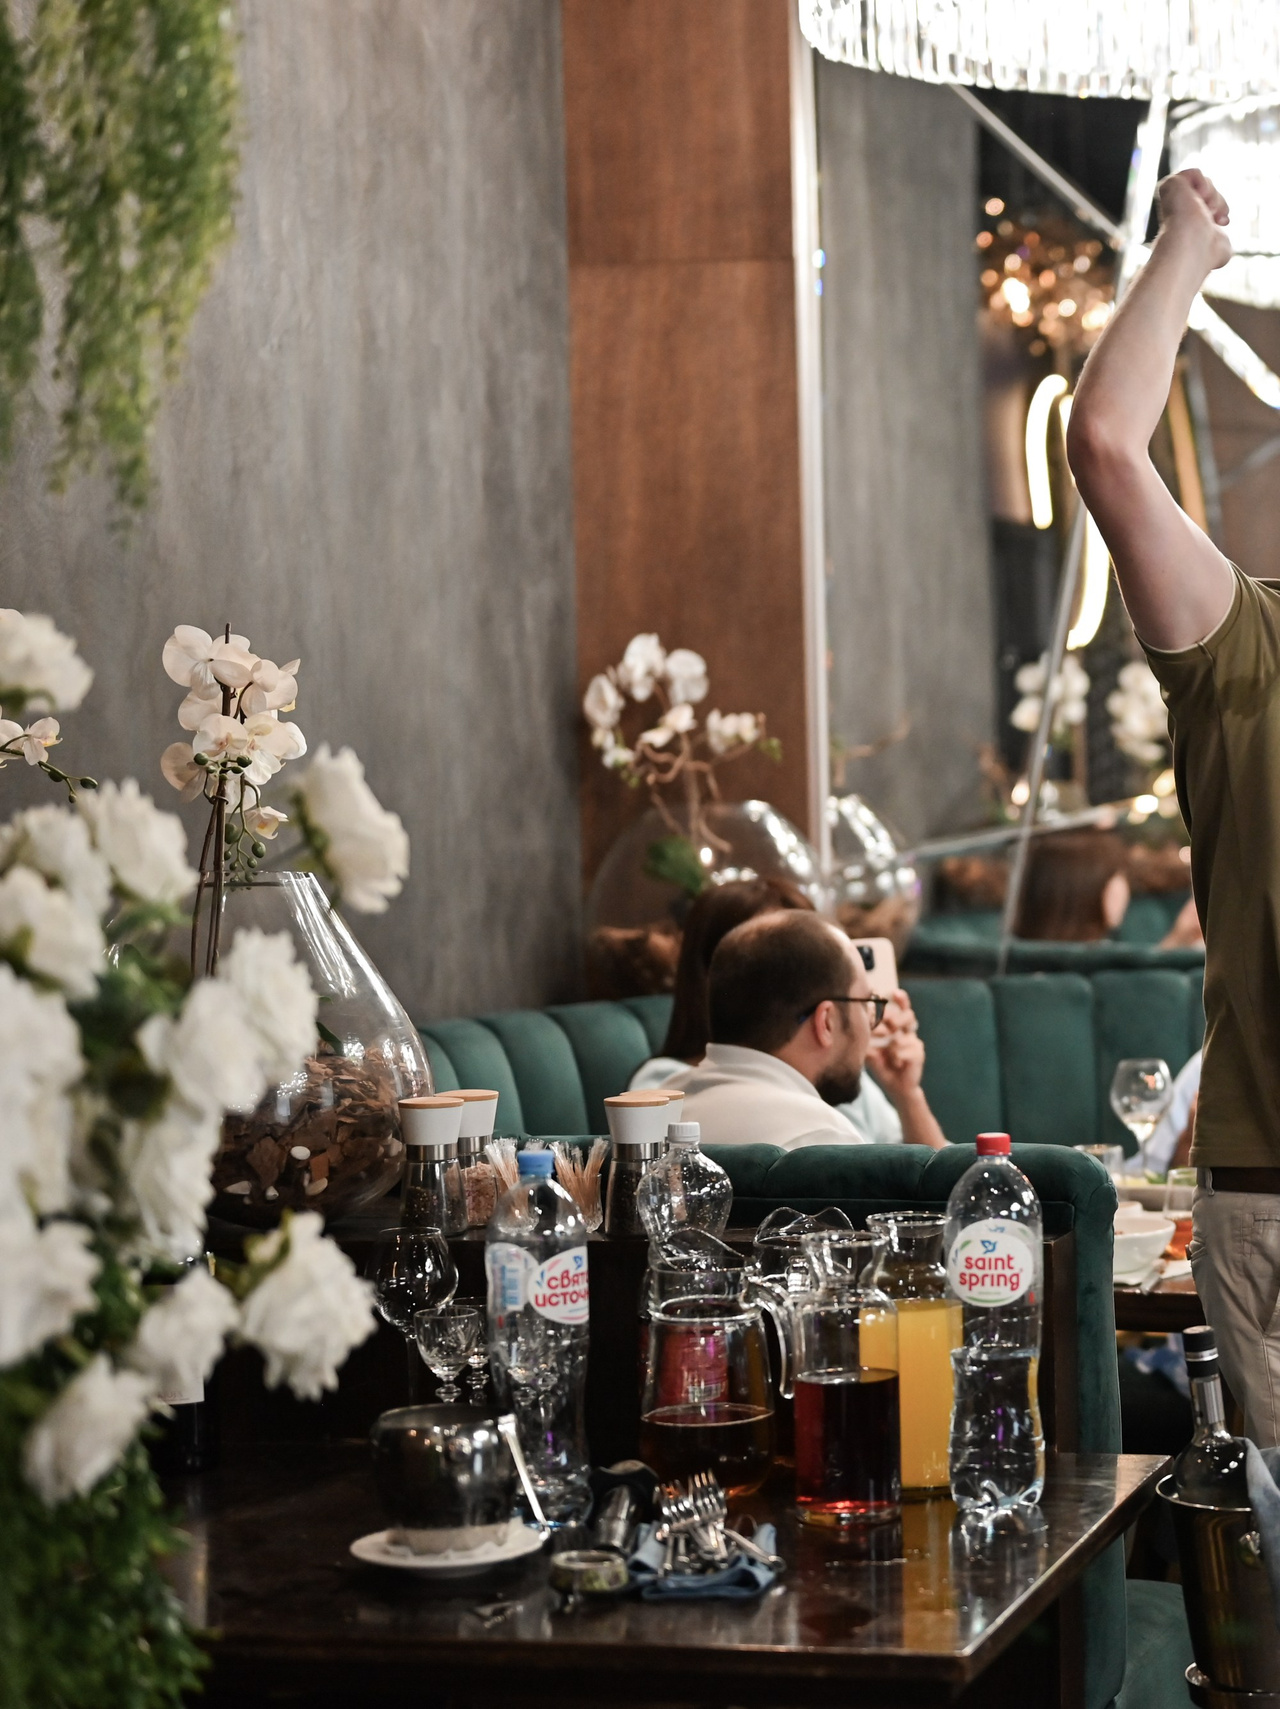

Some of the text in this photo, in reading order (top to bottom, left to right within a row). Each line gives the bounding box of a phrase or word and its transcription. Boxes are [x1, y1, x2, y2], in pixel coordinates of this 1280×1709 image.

[964, 1254, 1015, 1270] saint
[547, 1269, 589, 1290] свят
[959, 1272, 1021, 1292] spring
